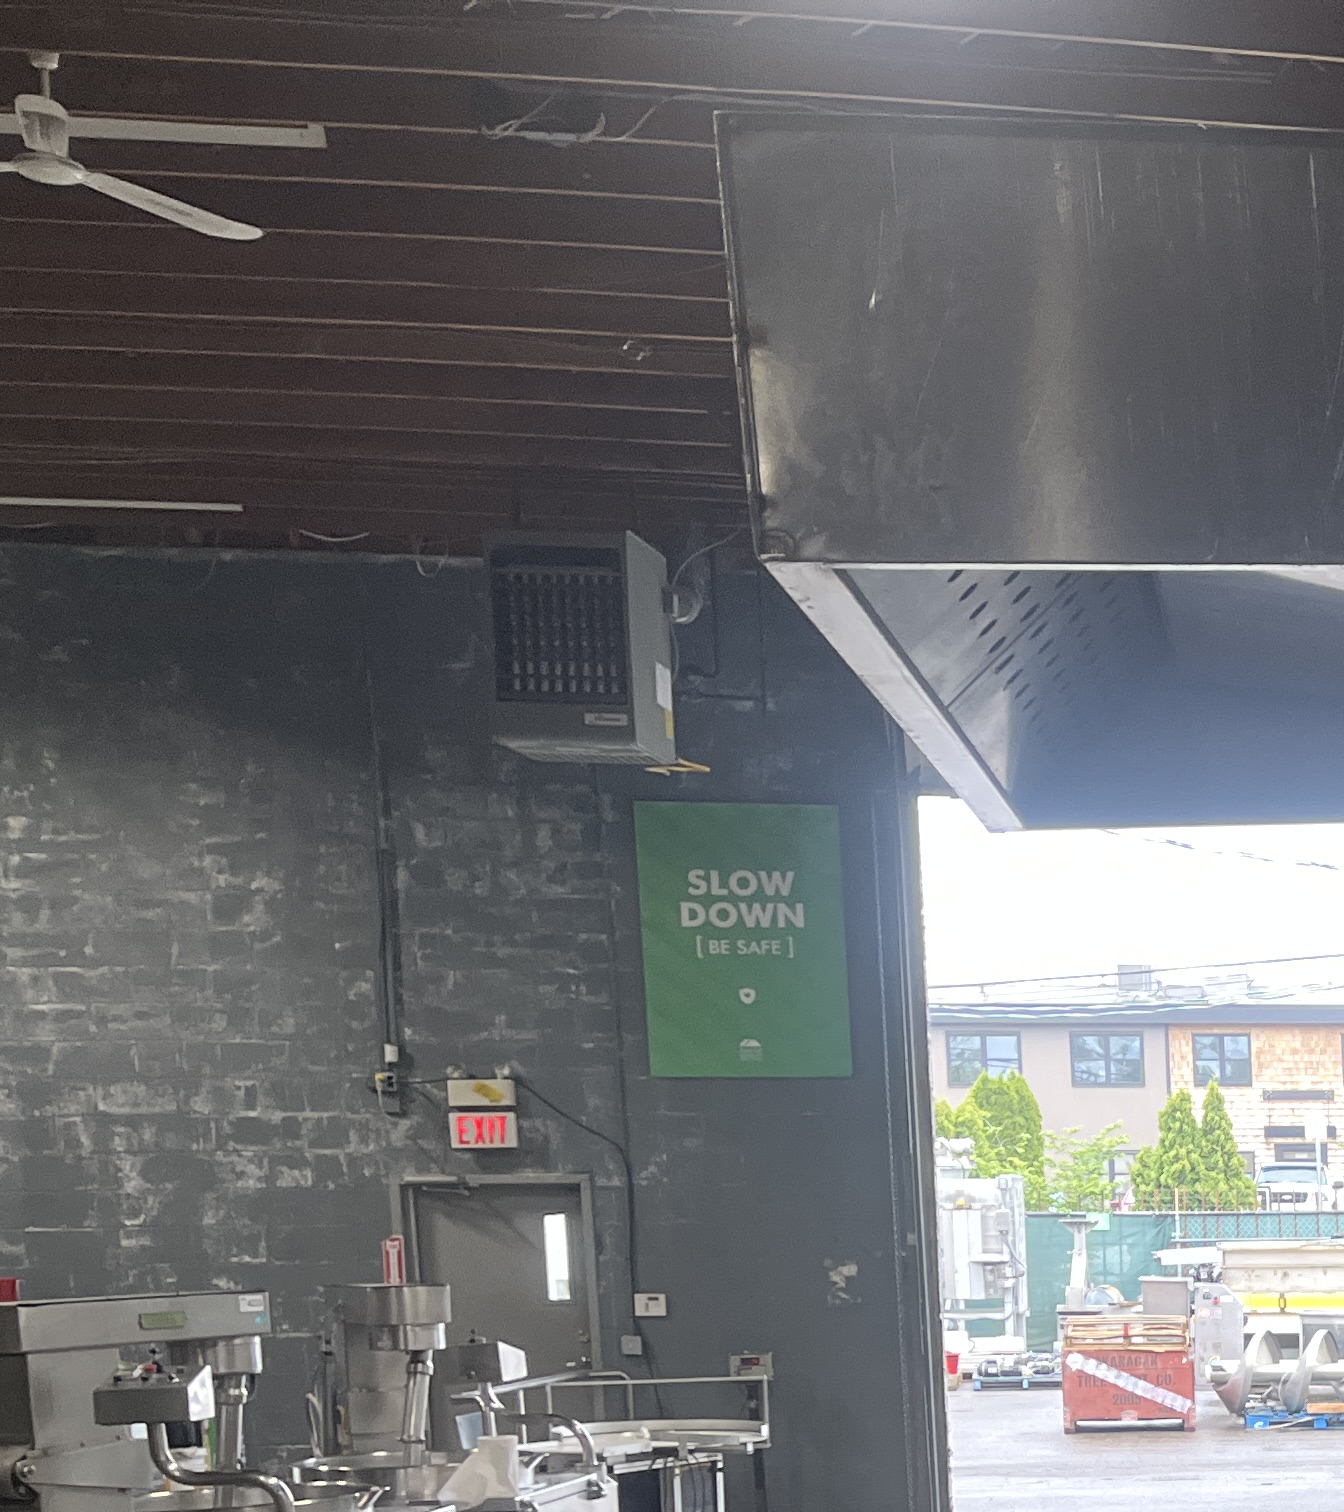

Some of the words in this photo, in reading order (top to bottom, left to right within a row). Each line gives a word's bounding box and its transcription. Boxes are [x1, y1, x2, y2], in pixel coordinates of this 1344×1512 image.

[687, 868, 795, 896] SLOW
[679, 901, 805, 928] DOWN
[456, 1115, 507, 1145] EXIT
